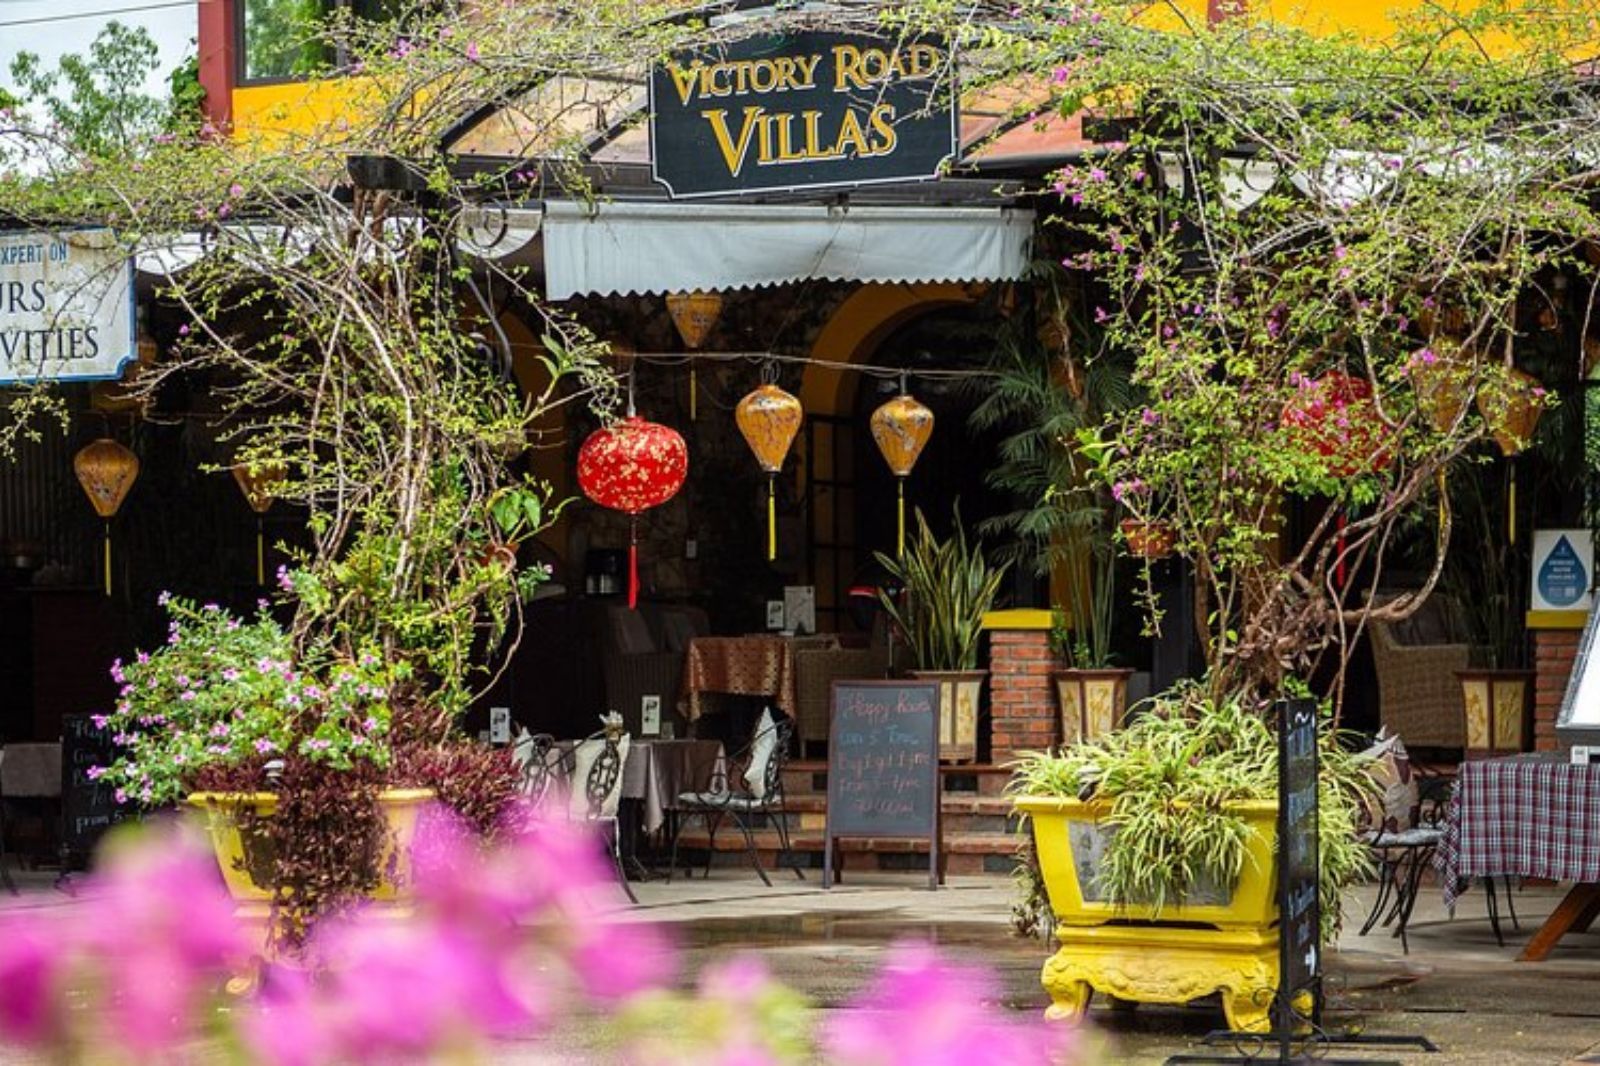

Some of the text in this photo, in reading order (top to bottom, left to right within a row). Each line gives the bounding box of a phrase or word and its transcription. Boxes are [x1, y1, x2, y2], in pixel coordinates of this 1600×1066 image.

[667, 43, 939, 106] VICTORY ROAD
[701, 102, 898, 178] VILLAS
[49, 240, 67, 261] ON
